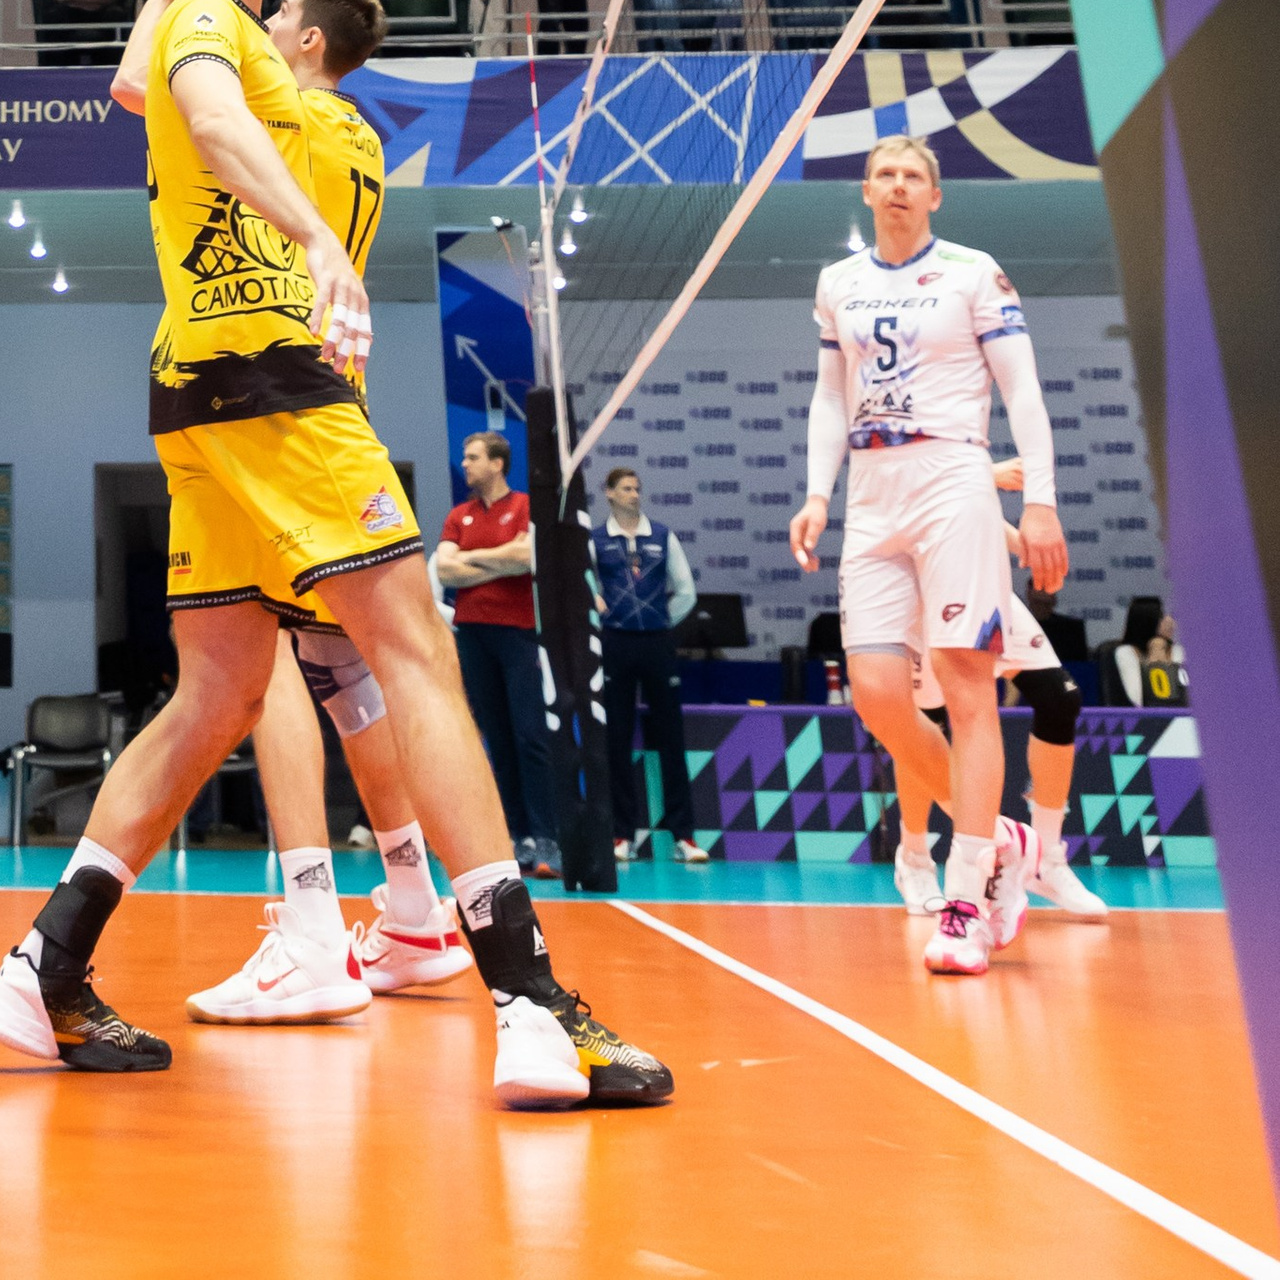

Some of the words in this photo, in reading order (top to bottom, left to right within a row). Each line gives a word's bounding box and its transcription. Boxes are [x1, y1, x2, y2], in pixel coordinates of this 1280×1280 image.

[346, 167, 380, 265] 17
[874, 317, 897, 371] 5
[1149, 667, 1171, 699] 0
